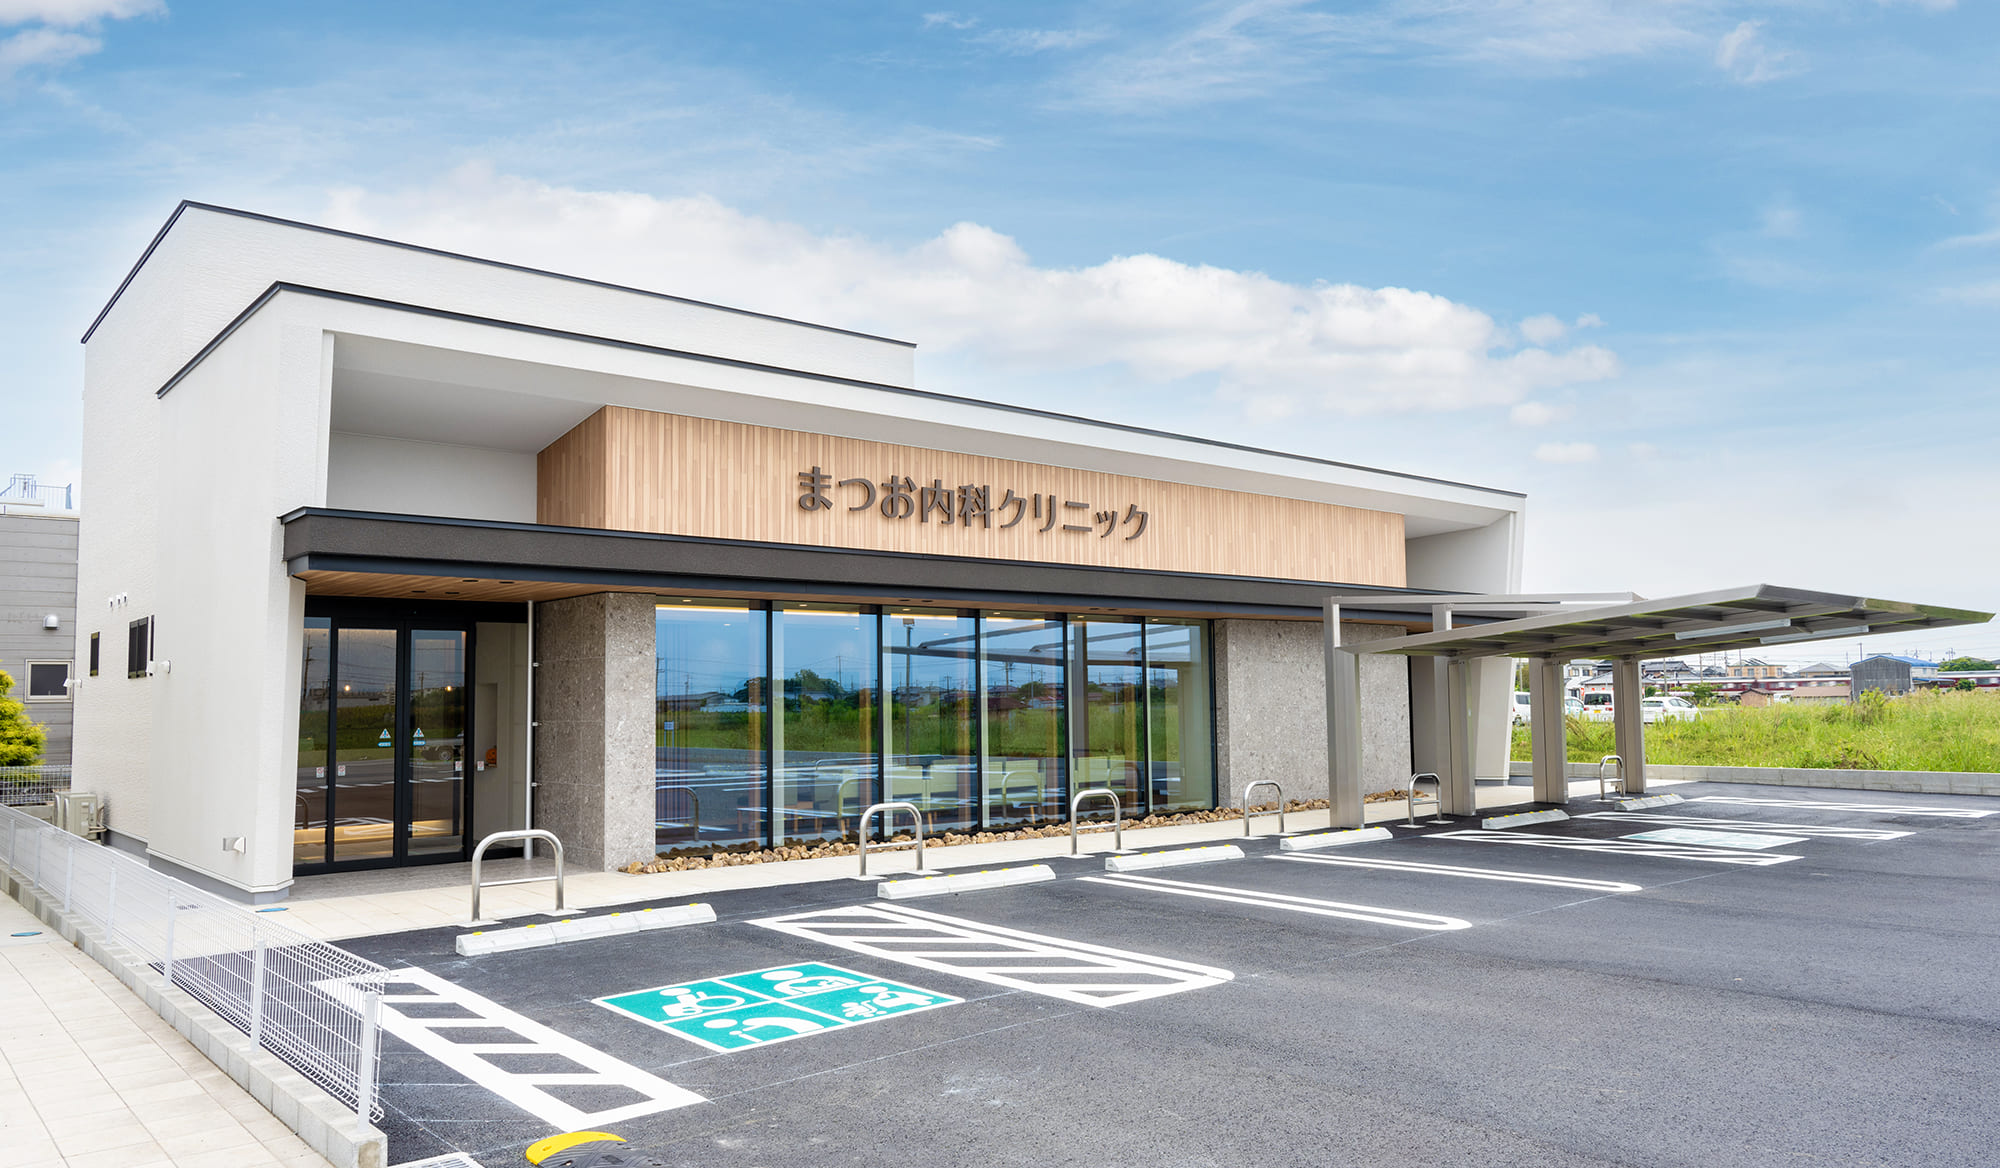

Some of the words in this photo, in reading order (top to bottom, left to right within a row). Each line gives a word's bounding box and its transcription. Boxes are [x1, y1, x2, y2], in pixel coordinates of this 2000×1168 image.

[798, 465, 1149, 541] まつお内科クリニック
